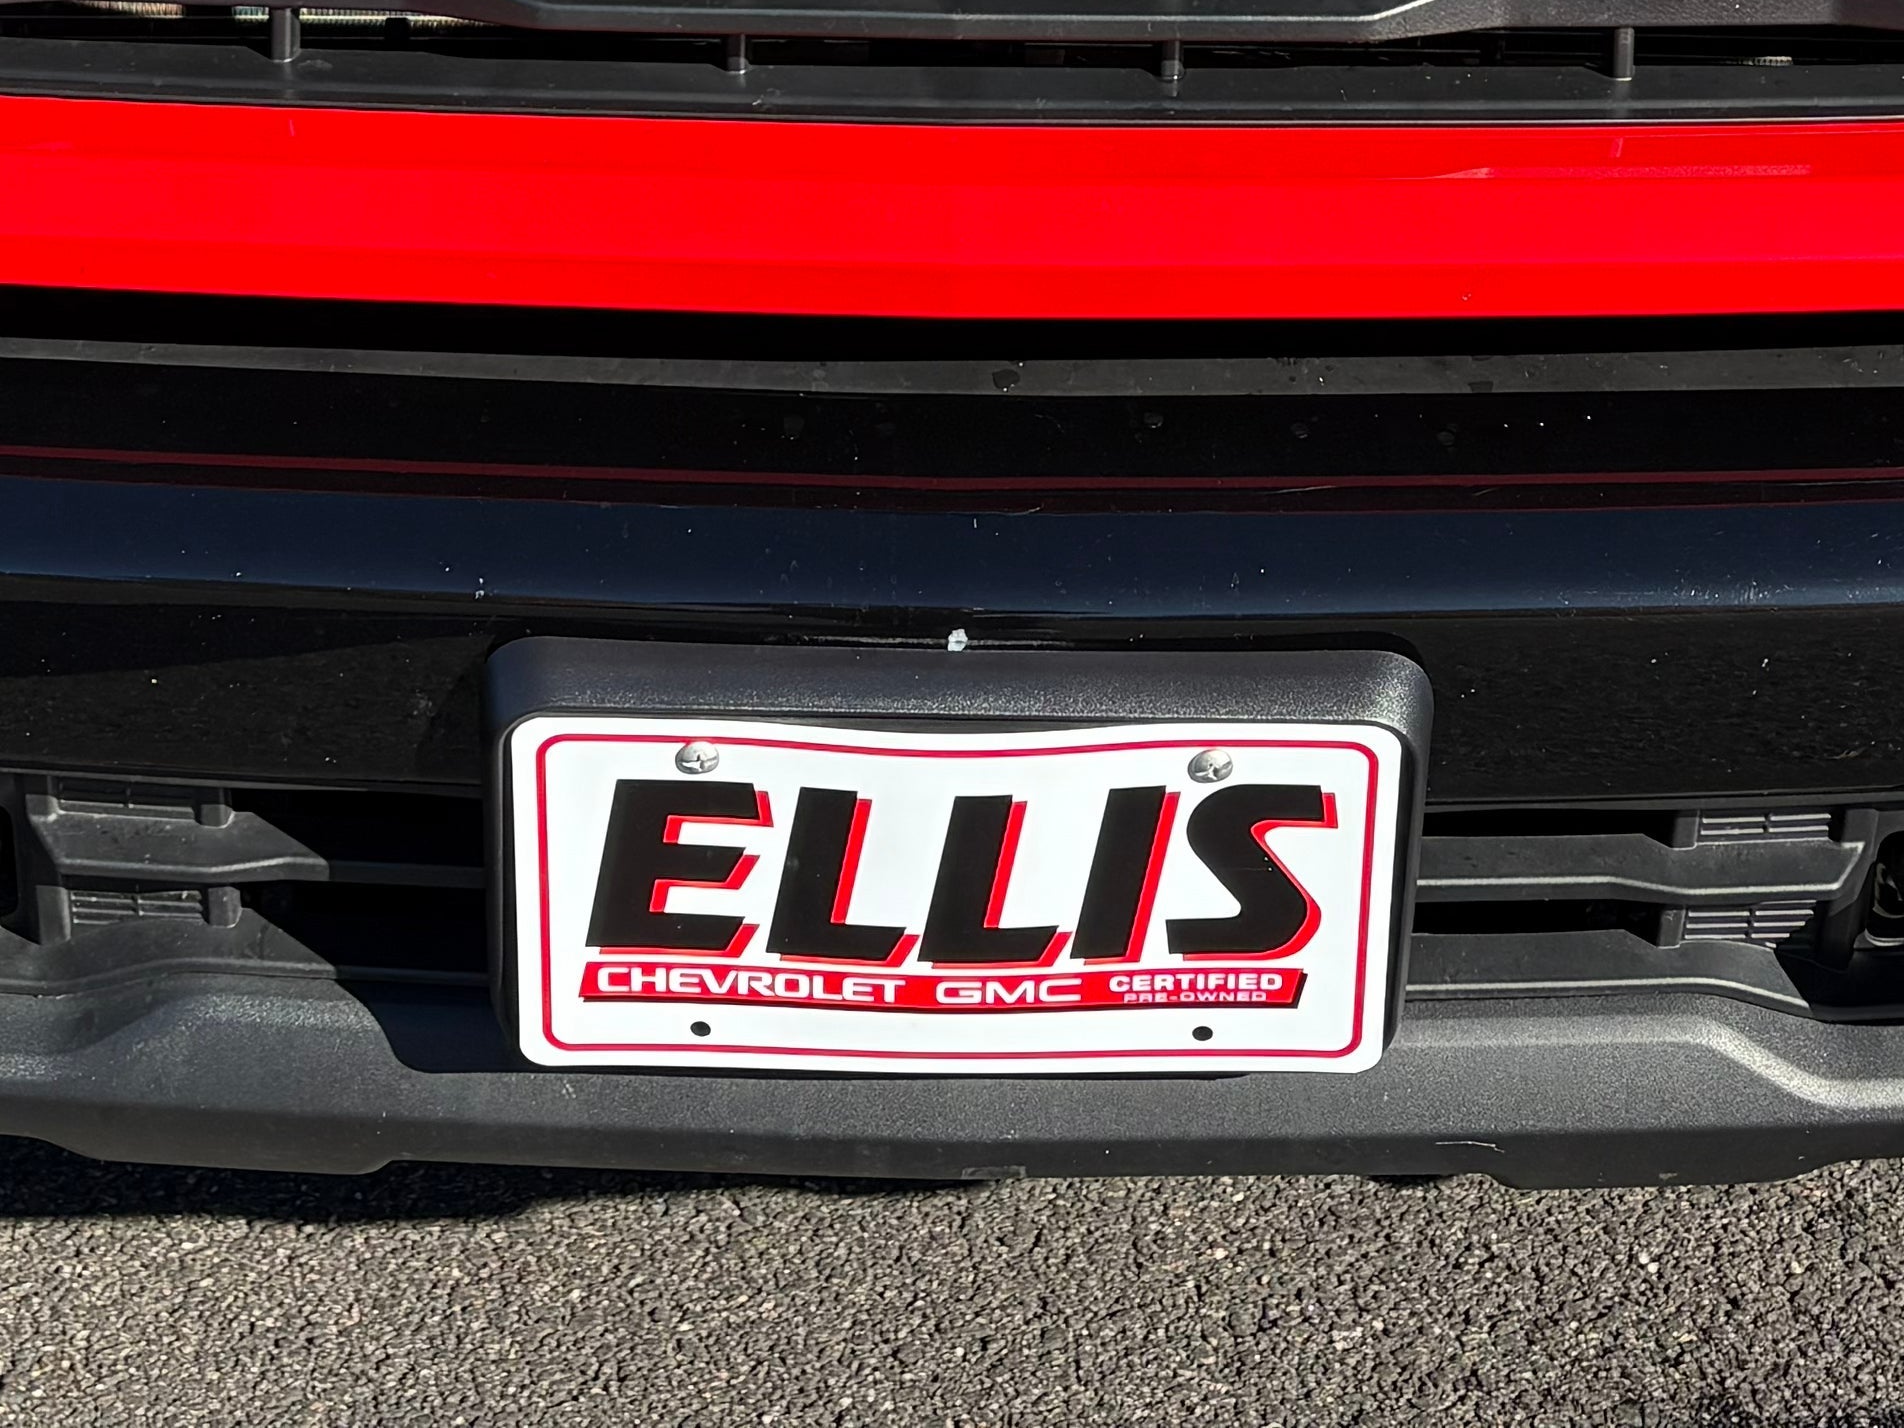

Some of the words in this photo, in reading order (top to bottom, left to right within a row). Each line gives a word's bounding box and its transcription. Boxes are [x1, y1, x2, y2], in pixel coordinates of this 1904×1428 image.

[585, 778, 1339, 969] ELLIS
[597, 966, 907, 1004] CHEVROLET
[934, 976, 1082, 1005] GMC
[1108, 972, 1283, 993] CERTIFIED
[1123, 991, 1267, 1004] PRE-OWNED
